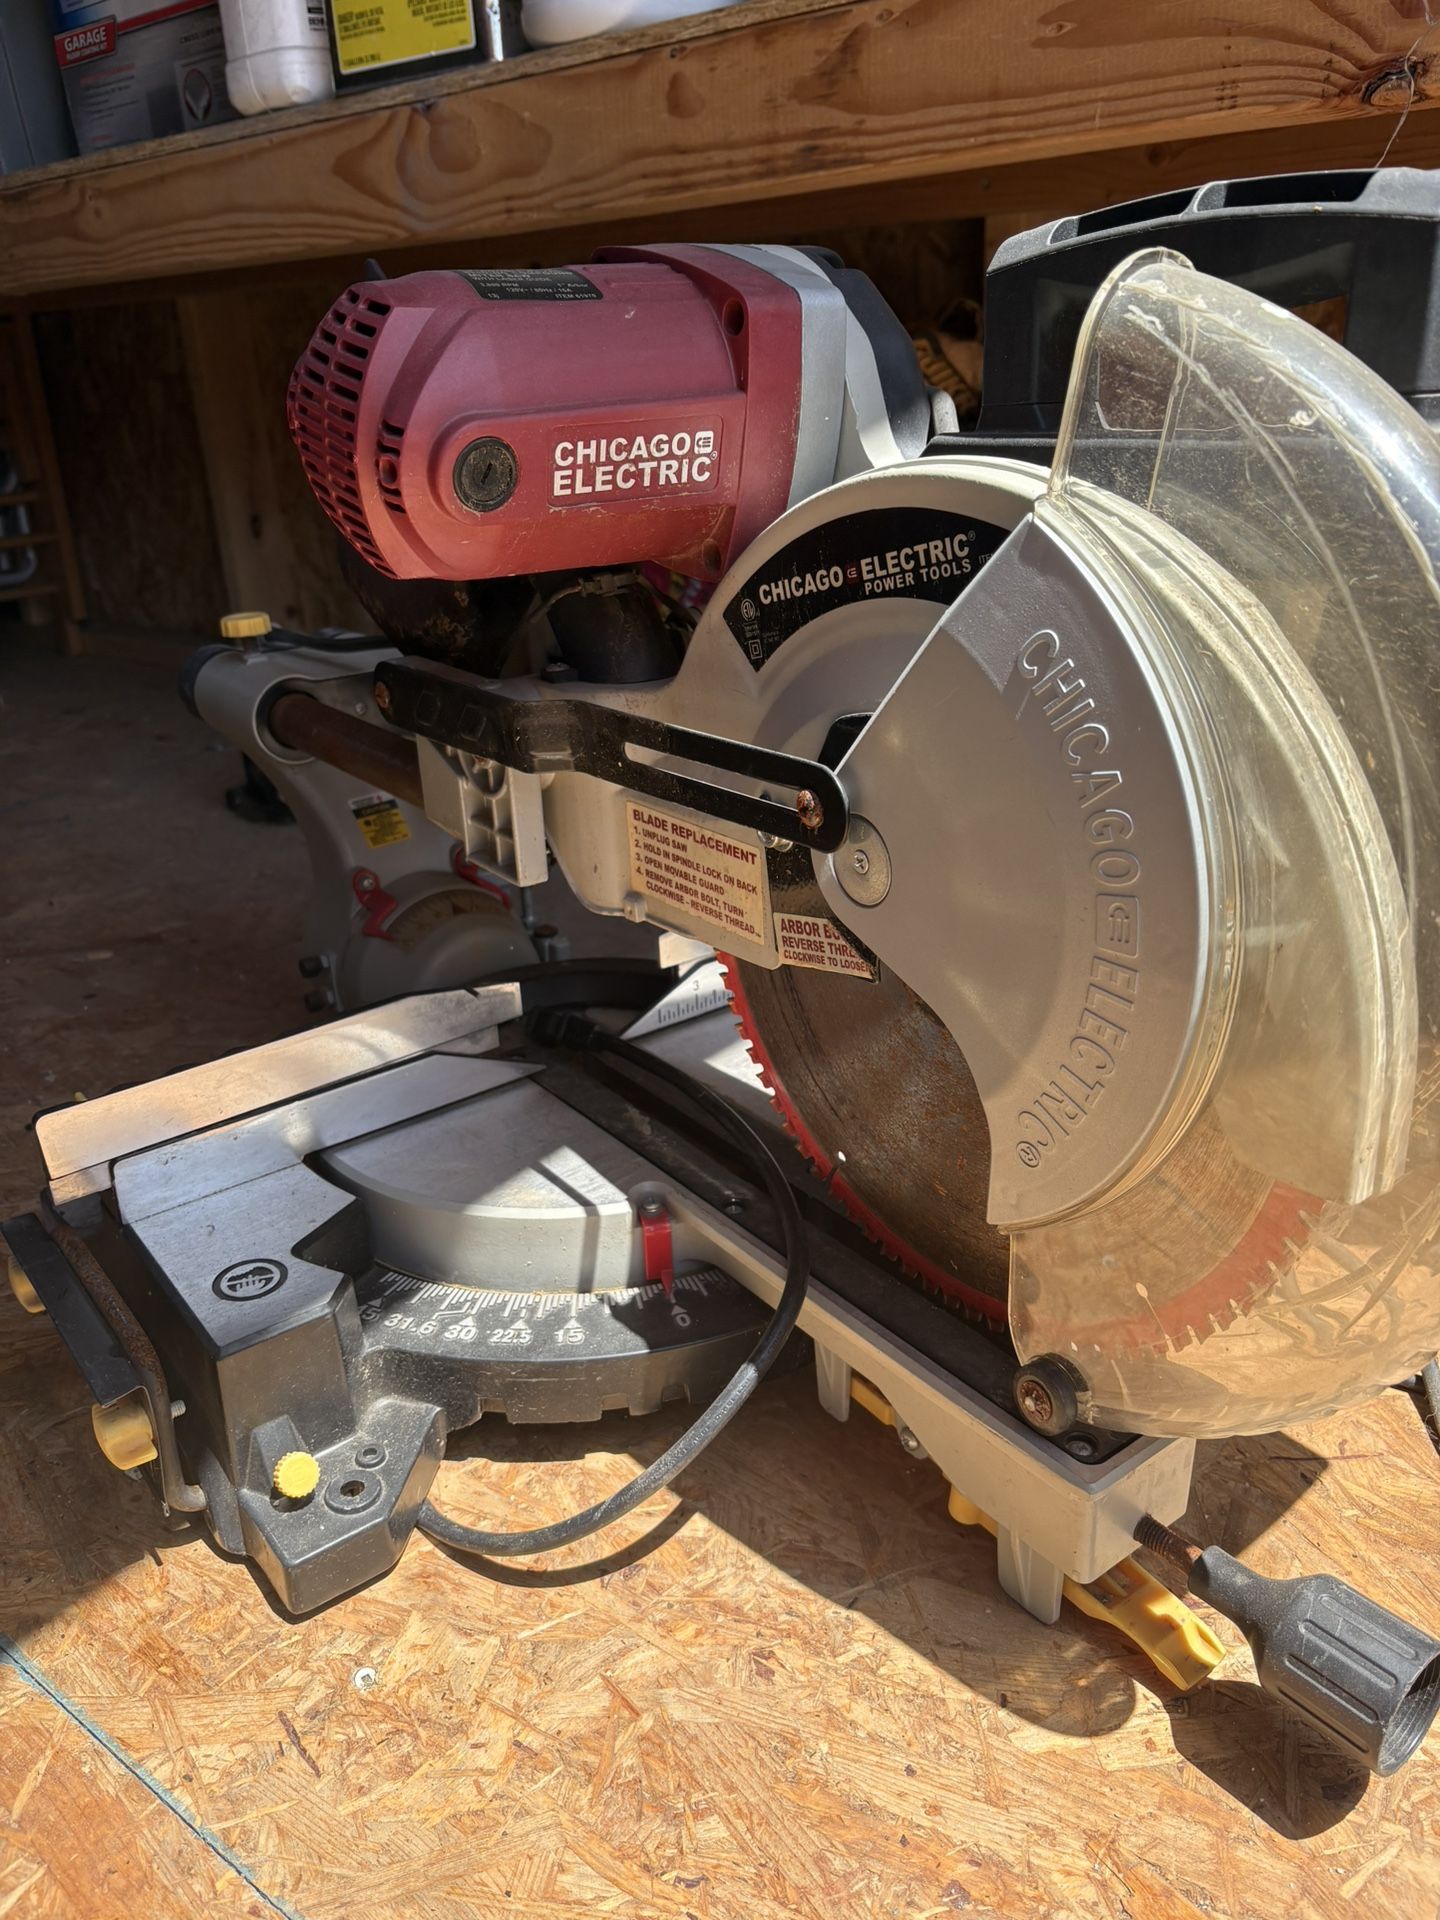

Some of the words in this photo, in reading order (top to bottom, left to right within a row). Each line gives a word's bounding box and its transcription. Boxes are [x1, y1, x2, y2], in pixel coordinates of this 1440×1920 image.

[64, 26, 108, 52] GARAGE
[554, 432, 692, 467] CHICAGO
[758, 565, 844, 606] CHICAGO
[864, 570, 915, 596] POWER
[922, 558, 972, 583] TOOLS
[1016, 629, 1142, 888] CHICAGO
[633, 809, 669, 833] BLADE
[671, 823, 758, 865] REPLACEMENT
[633, 826, 641, 836] 1.
[642, 828, 671, 847] UNPLUG
[671, 839, 688, 853] SAW
[634, 839, 642, 849] 2.
[643, 841, 662, 857] HOLD
[662, 849, 670, 860] IN
[671, 851, 702, 873] SPINDLE
[702, 864, 723, 881] LOCK
[723, 874, 735, 886] ON
[736, 879, 758, 896] BACK
[635, 852, 643, 863] 3.
[644, 856, 663, 872] OPEN
[664, 862, 698, 885] MOVABLE
[698, 877, 725, 896] GUARD
[636, 866, 644, 876] 4.
[645, 868, 674, 889] REMOVE
[674, 881, 700, 899] ARBOR
[700, 893, 721, 909] BOLT,
[722, 901, 745, 918] TURN
[646, 880, 685, 905] CLOCKWISE
[690, 900, 724, 921] REVERSE
[723, 913, 756, 935] THREAD
[780, 918, 822, 938] ARBOR
[781, 935, 826, 954] REVERSE
[783, 949, 826, 965] CLOCKWISE
[827, 956, 839, 967] TO
[692, 979, 700, 992] 3
[383, 1312, 438, 1336] 31.6
[443, 1324, 479, 1342] 30
[488, 1327, 533, 1345] 22.5
[553, 1326, 586, 1345] 15
[673, 1311, 692, 1328] 0
